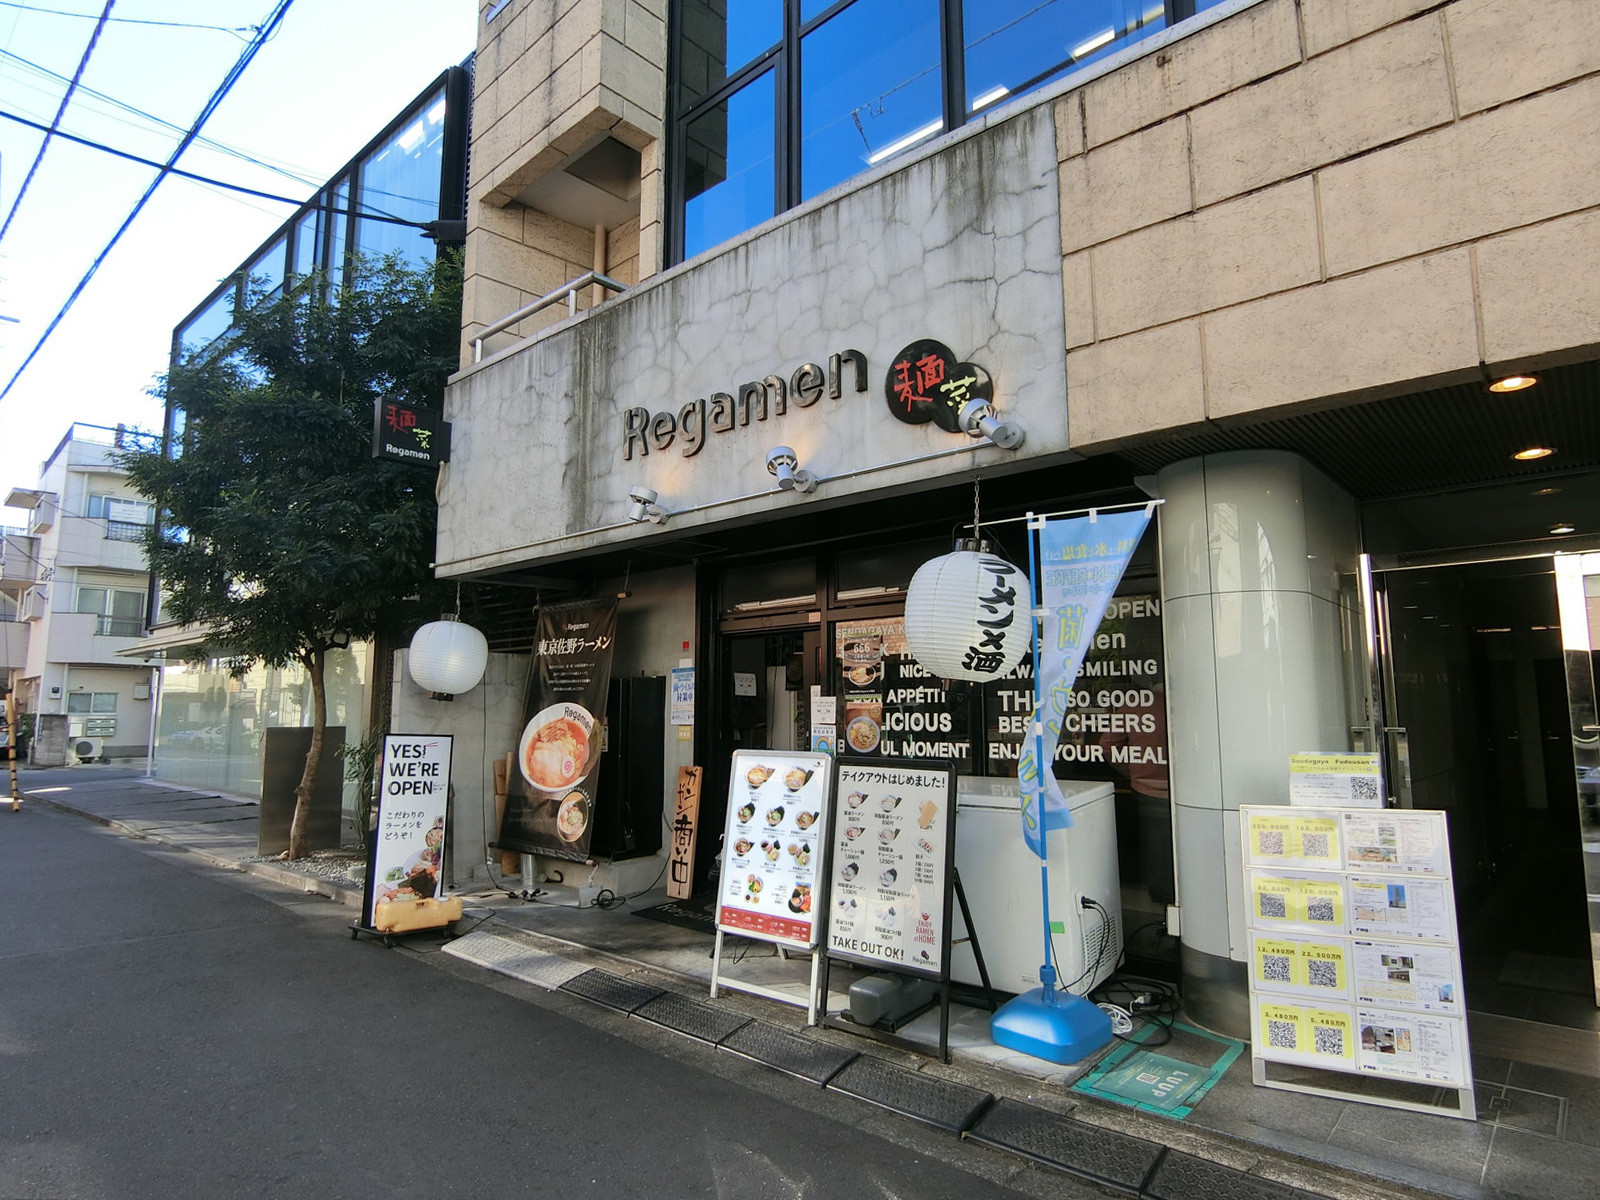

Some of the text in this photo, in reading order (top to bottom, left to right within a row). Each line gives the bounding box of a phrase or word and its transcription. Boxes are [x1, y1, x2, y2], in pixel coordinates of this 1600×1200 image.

[622, 349, 868, 461] Regamen
[386, 443, 430, 460] Regamen
[1105, 600, 1160, 619] OPEN
[536, 636, 612, 656] 東京佐野ラーメン
[1097, 689, 1154, 707] GOOD
[564, 706, 592, 733] Regamen
[998, 713, 1156, 733] BES CHEERS
[902, 741, 970, 759] MOMENT
[989, 742, 1167, 764] ENJ YOUR MEAL
[388, 781, 433, 796] OPEN
[385, 821, 422, 829] ラーメンを
[386, 812, 425, 820] こだわりの
[916, 926, 934, 936] RAMEN
[832, 935, 904, 960] TAKE OUT OK!
[912, 956, 938, 967] Regamen
[1152, 1070, 1190, 1098] LUUP
